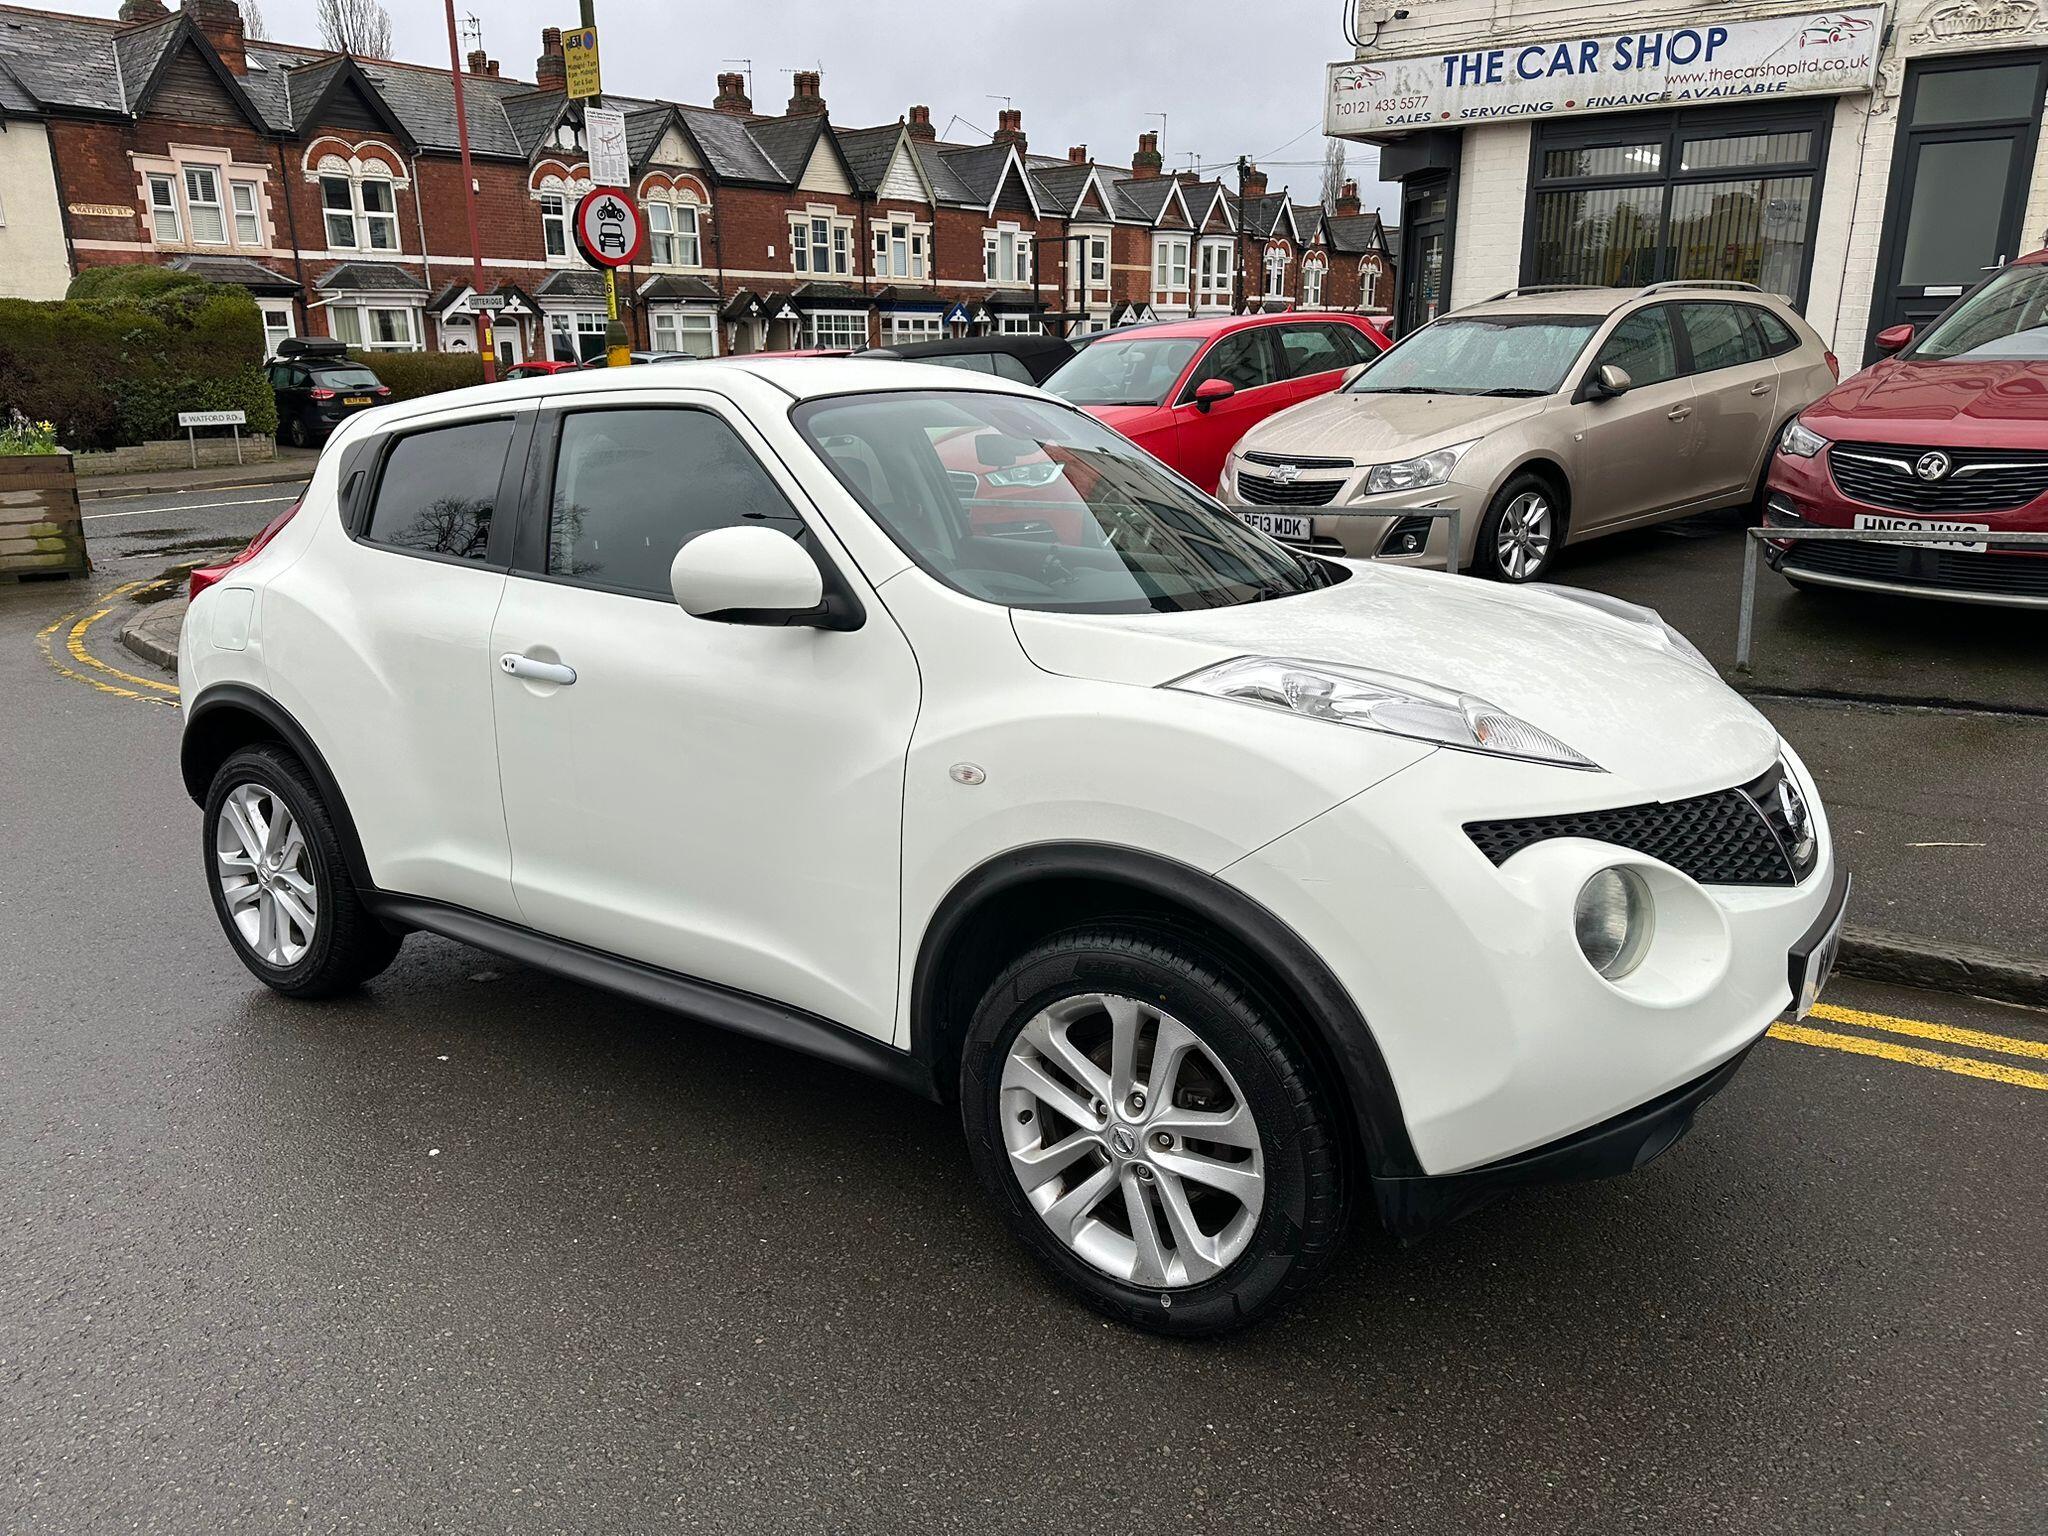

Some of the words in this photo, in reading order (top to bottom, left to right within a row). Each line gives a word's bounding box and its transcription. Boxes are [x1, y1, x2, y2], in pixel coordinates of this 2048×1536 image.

[1443, 50, 1504, 88] THE
[1516, 40, 1600, 80] CAR
[1612, 27, 1728, 72] SHOP
[1664, 54, 1869, 85] www.thecarshopltd.co.uk
[1336, 101, 1371, 116] T:0121
[1375, 98, 1397, 112] 433
[1400, 95, 1429, 110] 5577
[1385, 112, 1432, 125] SALES
[1460, 101, 1554, 119] SERVICING
[1586, 90, 1673, 108] FINANCE
[1678, 81, 1788, 100] AVAILABLE
[1275, 517, 1302, 536] MDK
